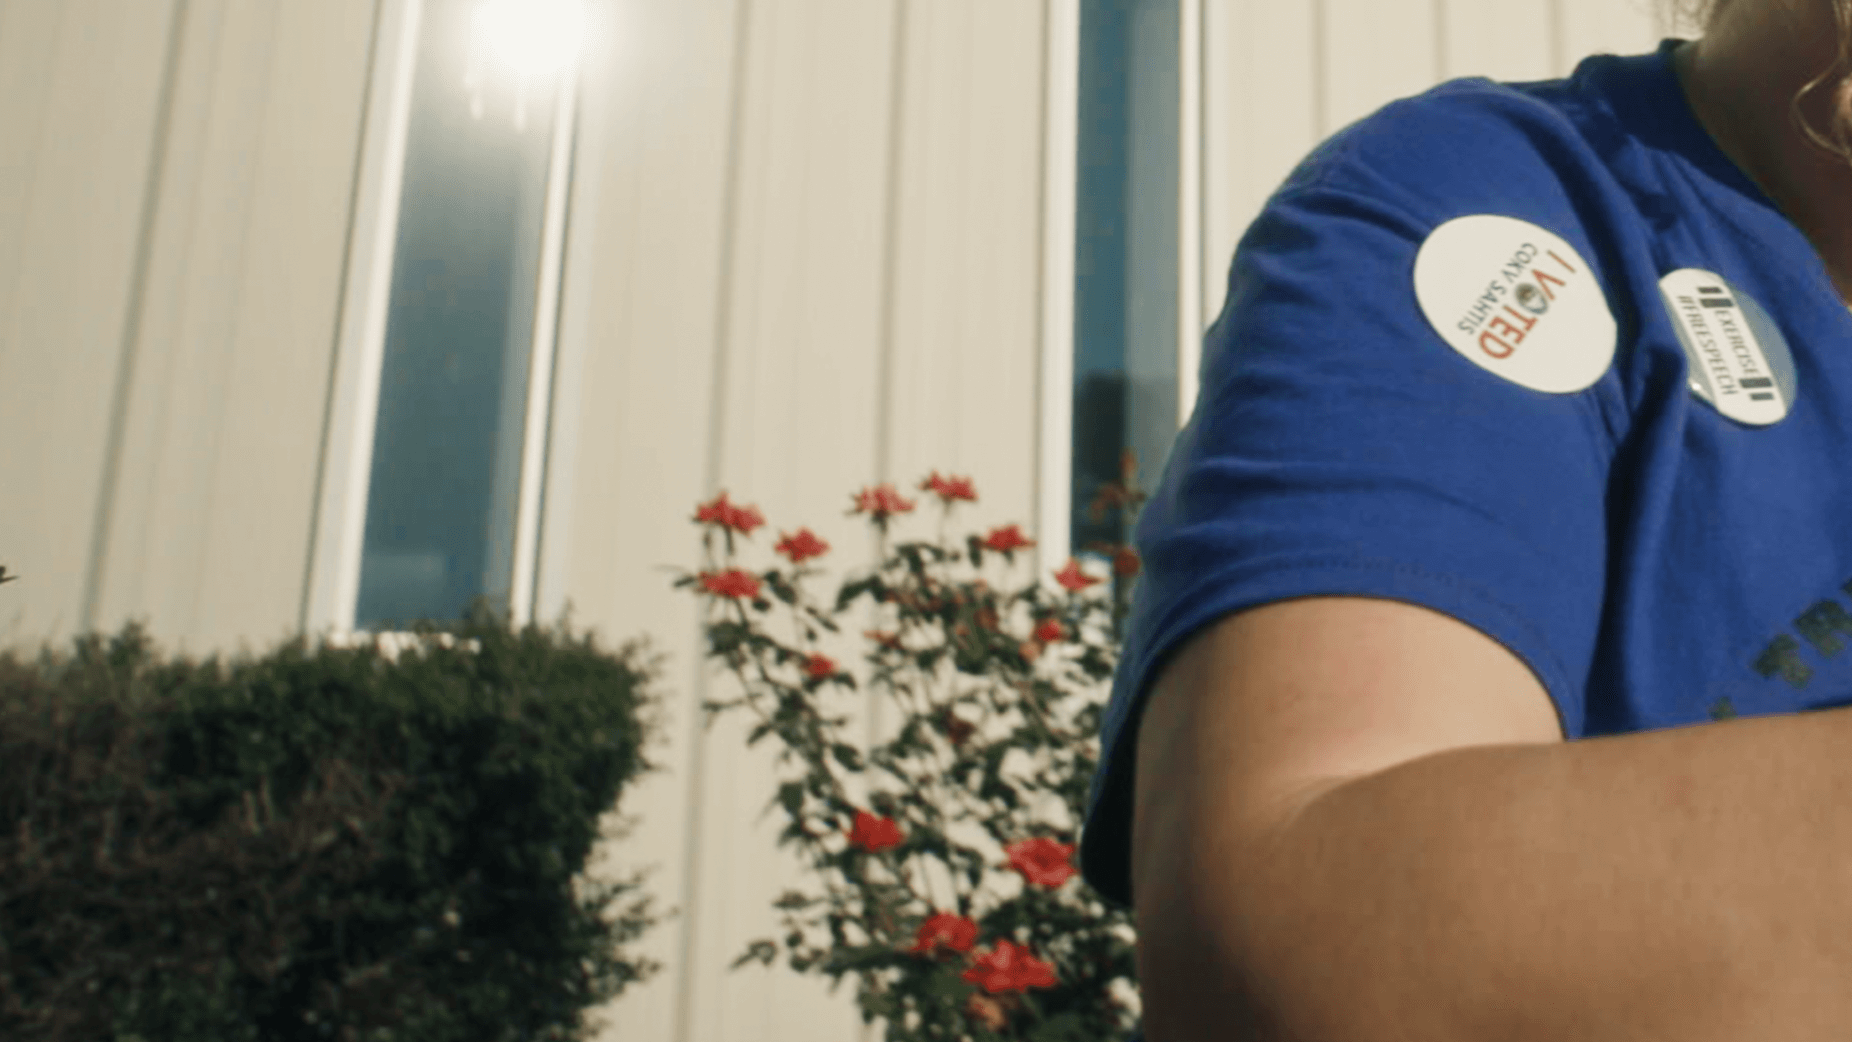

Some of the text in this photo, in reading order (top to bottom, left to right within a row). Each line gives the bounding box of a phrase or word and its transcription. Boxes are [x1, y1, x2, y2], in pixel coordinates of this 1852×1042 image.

[1478, 249, 1576, 360] I VOTED
[1714, 309, 1759, 377] EXERCISE
